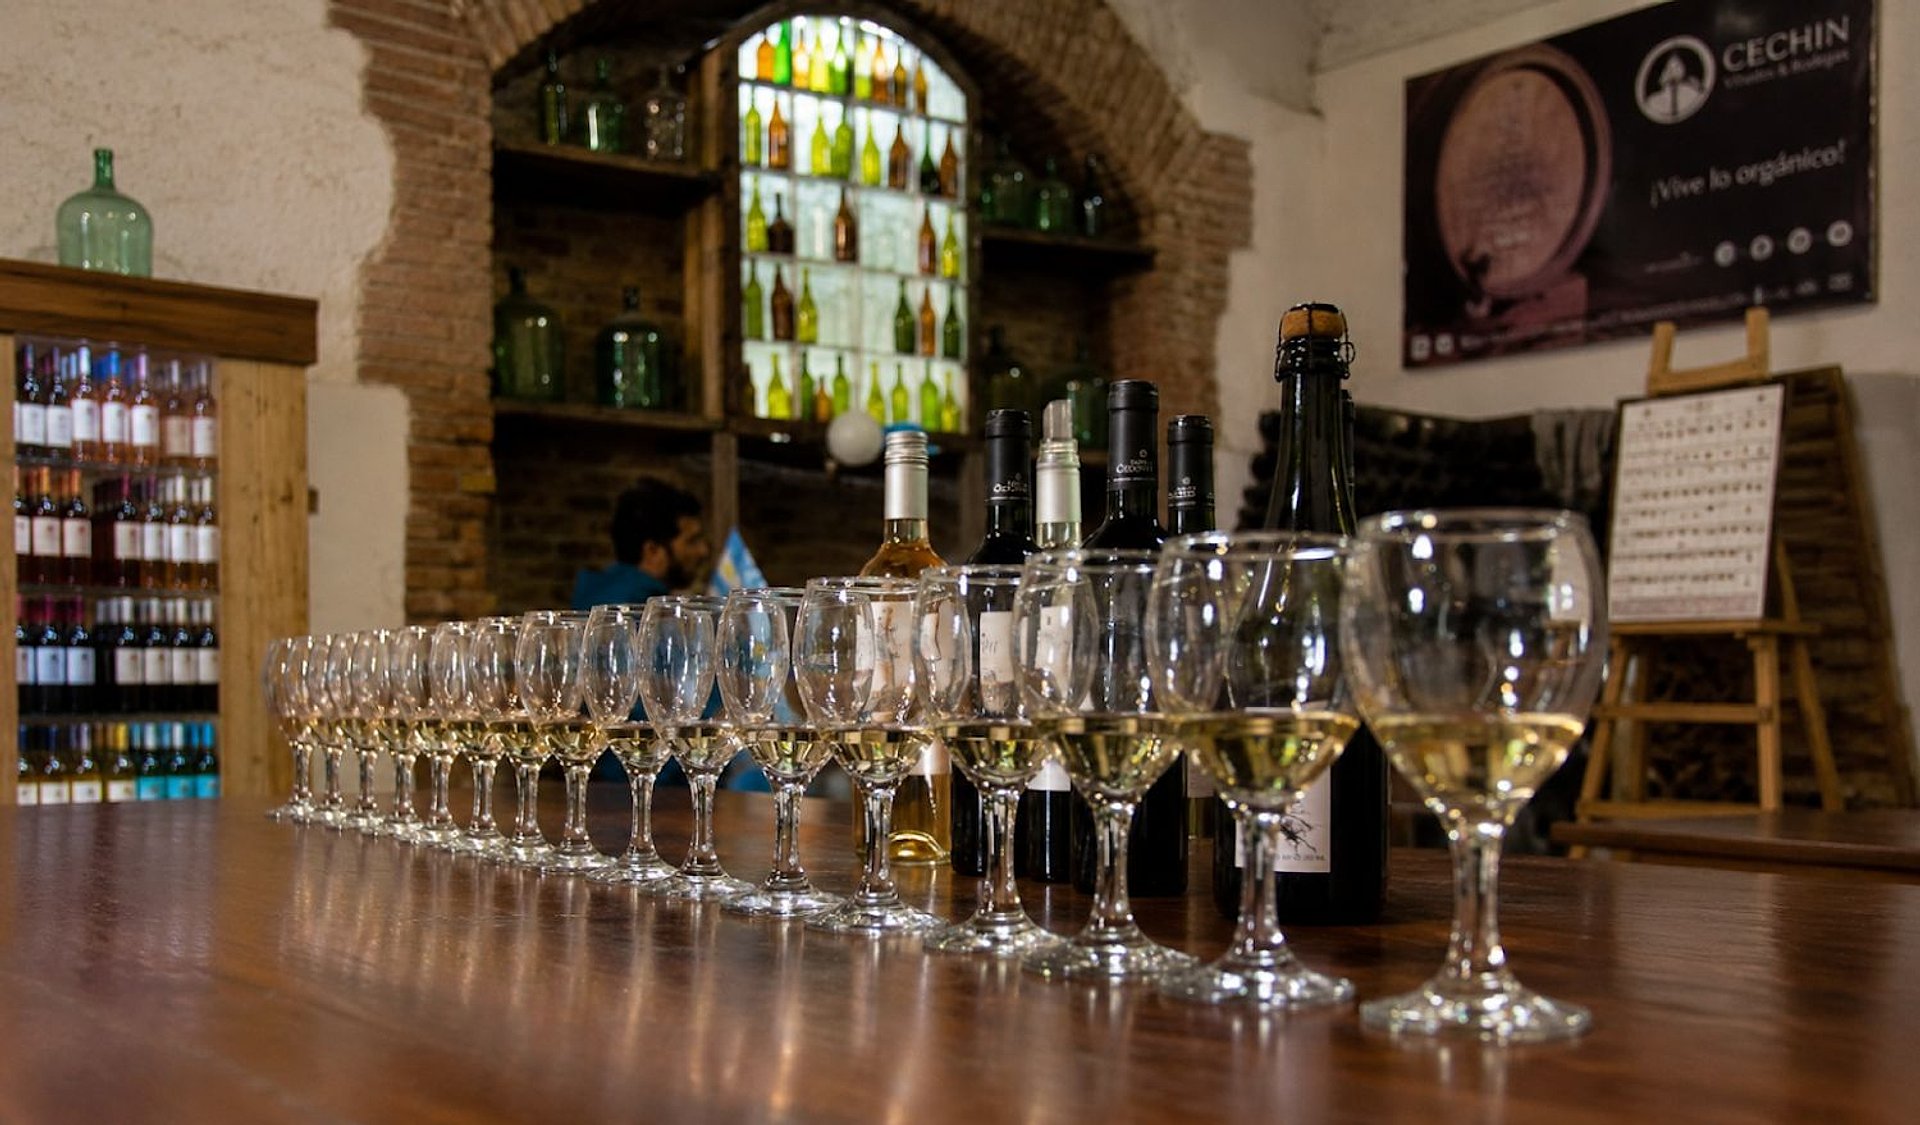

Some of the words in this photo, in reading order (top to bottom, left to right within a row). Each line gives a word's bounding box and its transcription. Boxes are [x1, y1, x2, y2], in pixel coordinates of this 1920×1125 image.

[1722, 14, 1849, 72] CECHIN
[1709, 165, 1732, 190] lo
[1735, 138, 1846, 187] orgánico!
